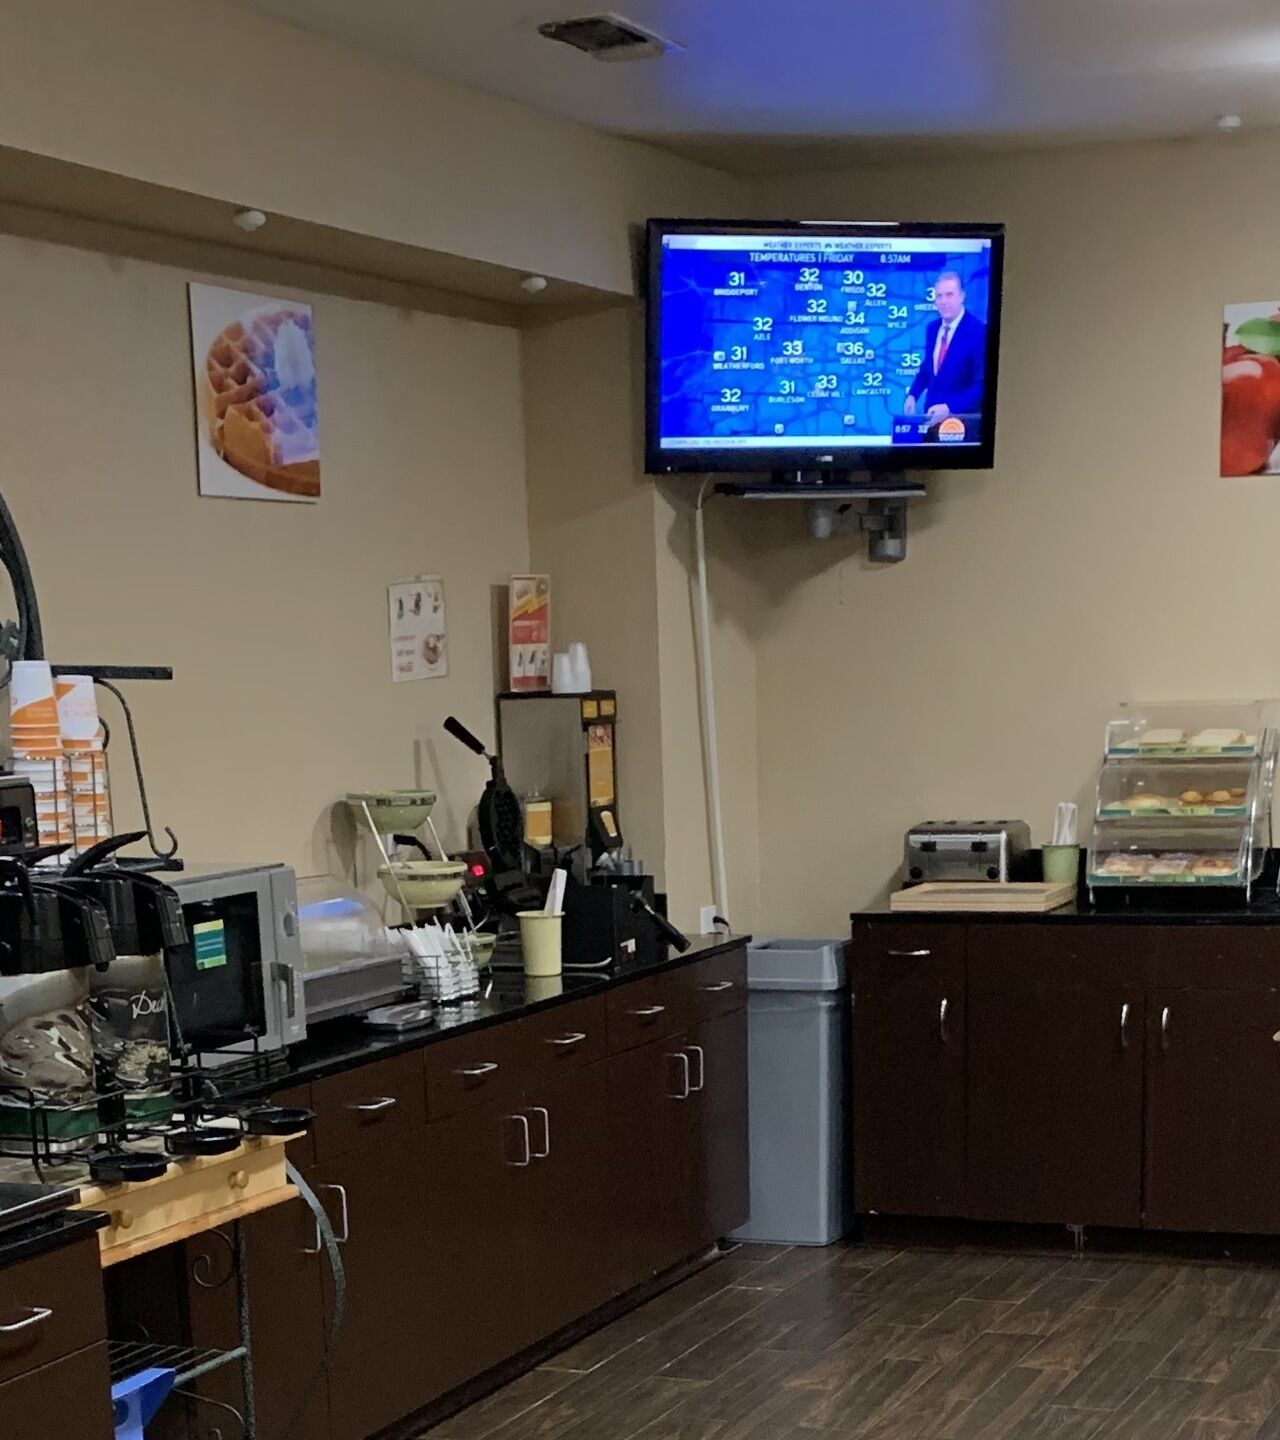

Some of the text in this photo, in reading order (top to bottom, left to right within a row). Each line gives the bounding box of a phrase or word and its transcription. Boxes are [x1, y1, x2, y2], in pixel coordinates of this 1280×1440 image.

[749, 252, 816, 262] TEMPERATURES
[823, 254, 855, 262] FRIDAY
[728, 272, 746, 286] 31
[799, 268, 820, 282] 32
[842, 270, 864, 285] 30
[866, 283, 886, 297] 32
[926, 287, 936, 302] 3
[806, 299, 828, 313] 32
[888, 305, 908, 319] 34
[752, 317, 774, 332] 32
[845, 312, 865, 325] 34
[731, 346, 748, 360] 31
[782, 340, 804, 355] 33
[846, 342, 864, 355] 36
[712, 362, 766, 370] WEATHERFORD
[901, 353, 920, 367] 35
[818, 375, 838, 388] 33
[863, 372, 883, 386] 32
[779, 380, 796, 394] 31
[720, 388, 742, 402] 32
